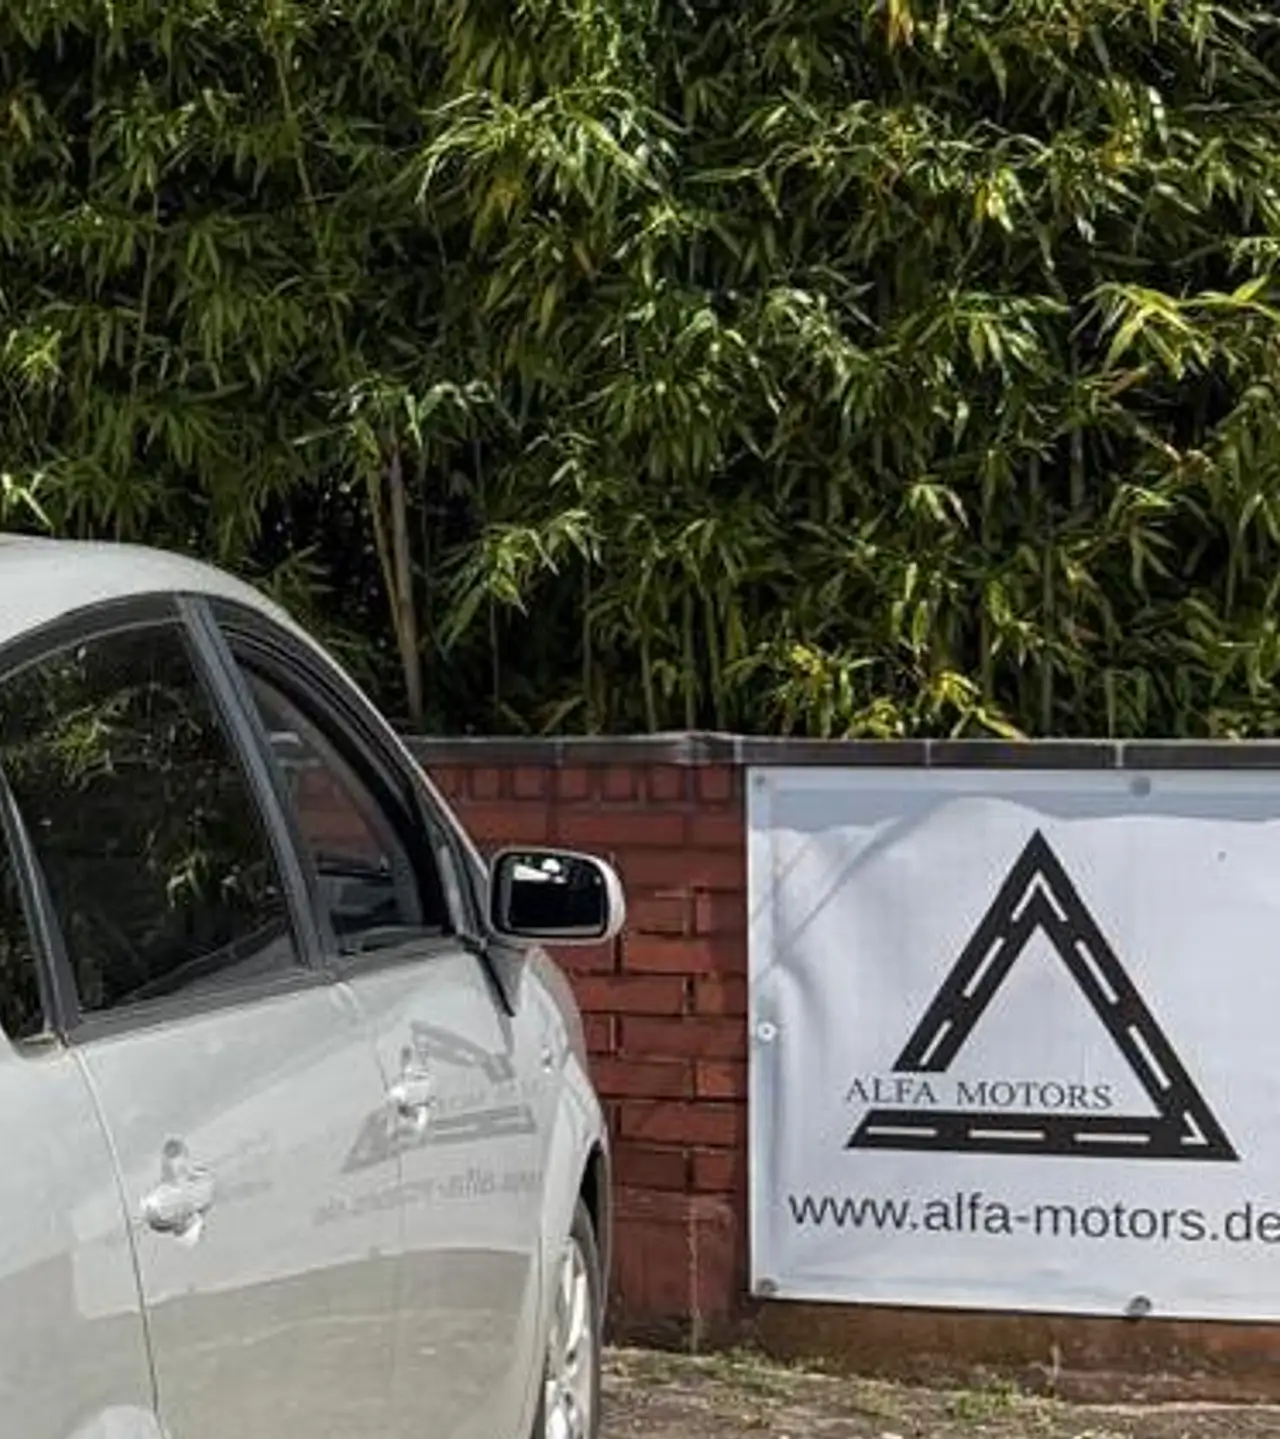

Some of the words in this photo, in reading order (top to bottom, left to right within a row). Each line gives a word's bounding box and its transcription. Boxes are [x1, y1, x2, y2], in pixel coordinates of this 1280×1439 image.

[845, 1077, 939, 1104] ALFA
[956, 1081, 1113, 1109] MOTORS
[787, 1191, 1280, 1242] www.alfa-motors.de
